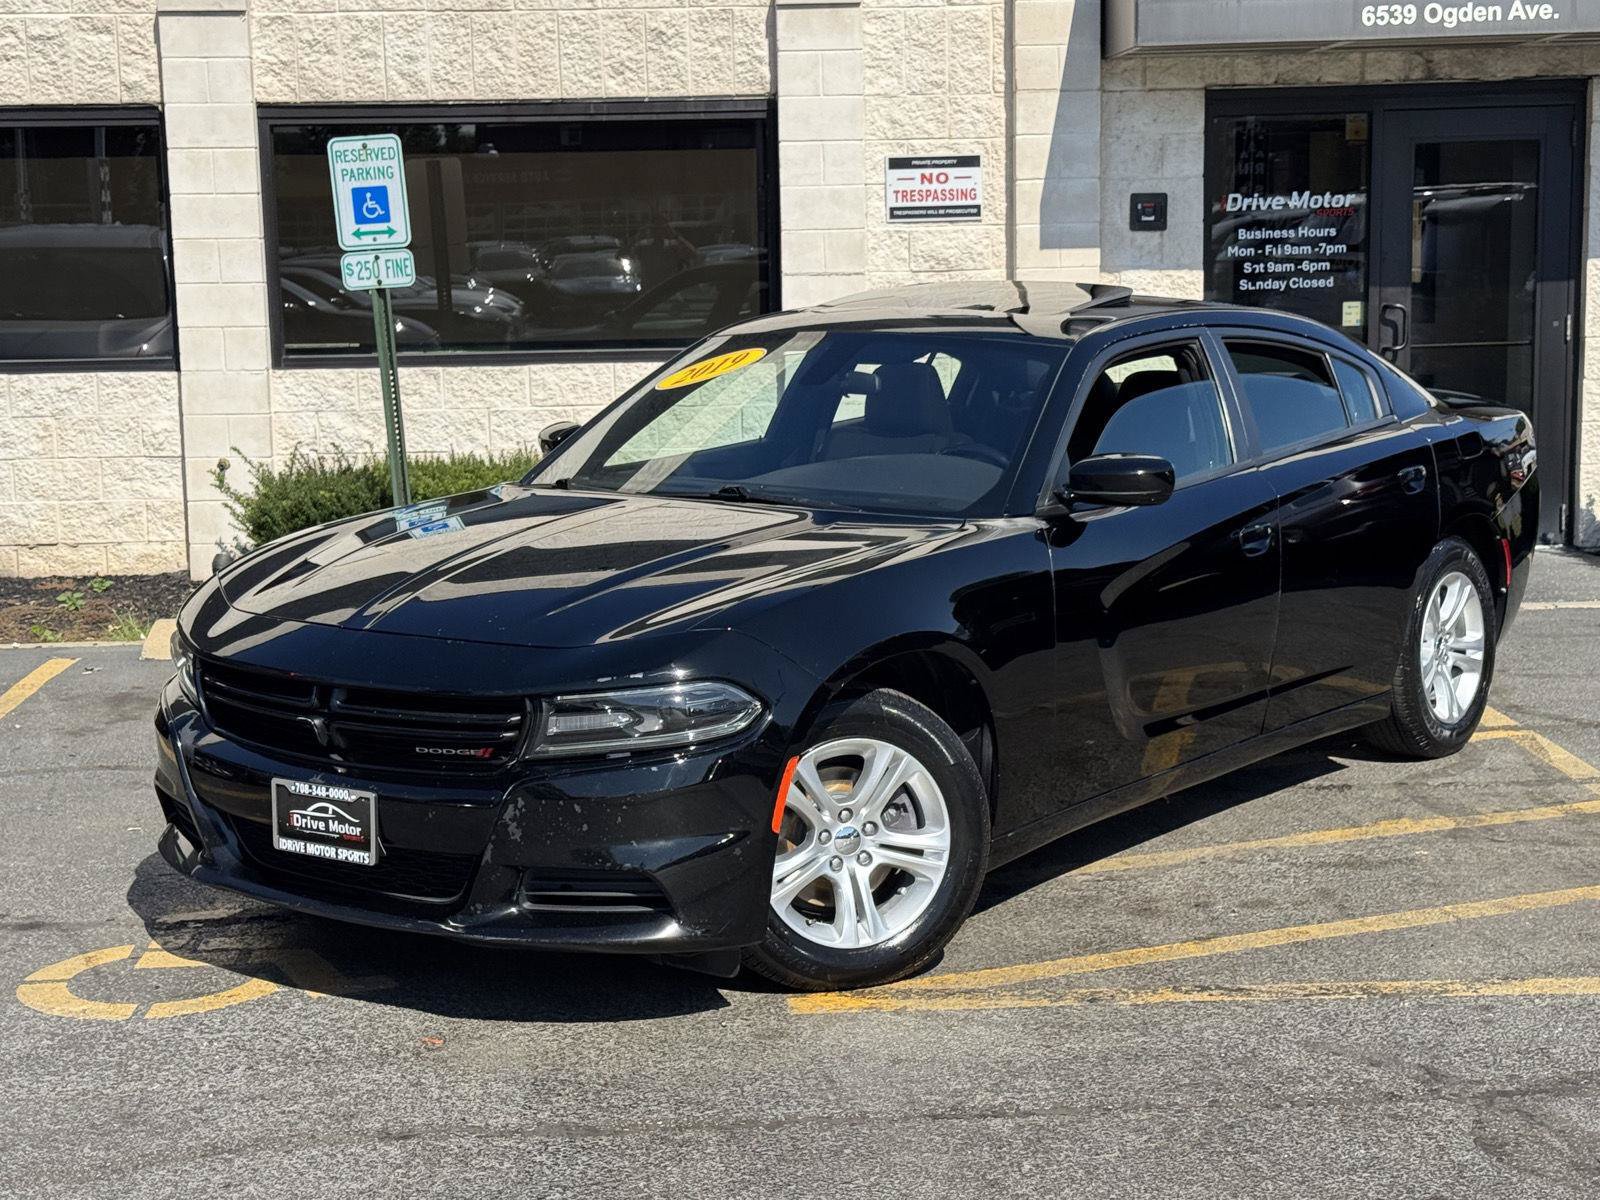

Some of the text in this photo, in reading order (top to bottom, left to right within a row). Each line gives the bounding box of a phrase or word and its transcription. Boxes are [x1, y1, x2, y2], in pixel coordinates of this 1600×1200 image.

[1361, 0, 1560, 28] 6539 Ogden Ave.
[335, 146, 396, 164] RESERVED
[341, 165, 394, 182] PARKING
[920, 171, 949, 185] NO
[893, 187, 977, 203] TRESPASSING
[1290, 190, 1357, 209] Motor
[1238, 226, 1337, 240] Business Hours
[1227, 246, 1255, 257] Mon
[1284, 244, 1312, 256] 9am
[345, 257, 412, 281] $250 FINE
[1267, 261, 1295, 273] 9am
[1289, 276, 1334, 289] Closed
[670, 352, 750, 386] 2019
[415, 746, 482, 756] DODGE
[328, 819, 362, 836] Motor
[306, 842, 337, 859] MOTOR
[337, 848, 370, 864] SPORTS
